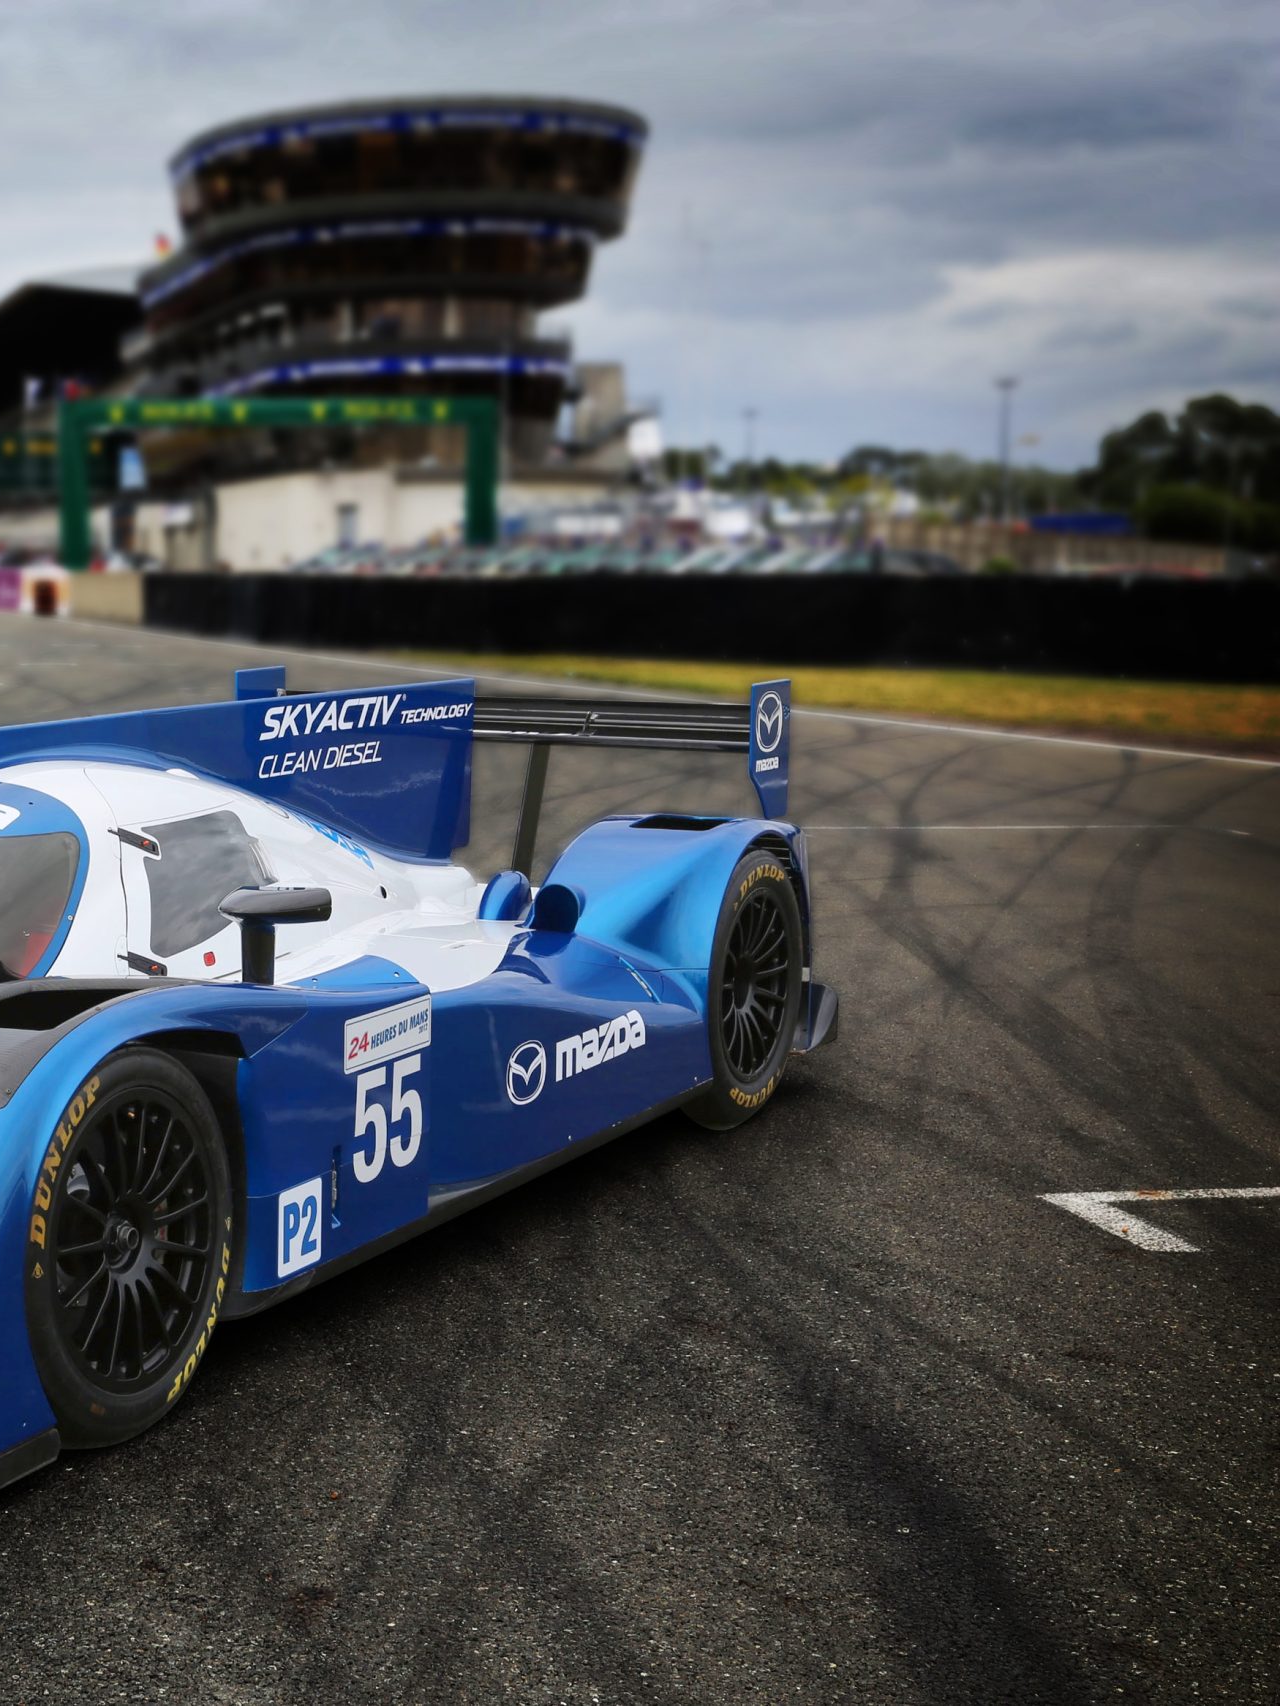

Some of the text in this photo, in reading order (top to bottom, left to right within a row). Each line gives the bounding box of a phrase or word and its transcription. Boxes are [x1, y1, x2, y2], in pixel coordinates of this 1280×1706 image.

[259, 693, 473, 741] SKYACTIV TECHNOLOGY
[258, 741, 382, 779] CLEAN DIESEL
[739, 863, 786, 900] DUNLOP
[348, 1008, 429, 1060] 24 HEURES DU MANS
[729, 1076, 775, 1108] DUNLOP
[353, 1053, 423, 1184] 55
[29, 1074, 101, 1250] DUNLOP
[283, 1195, 318, 1265] P2
[167, 1242, 230, 1403] DUNLOP
